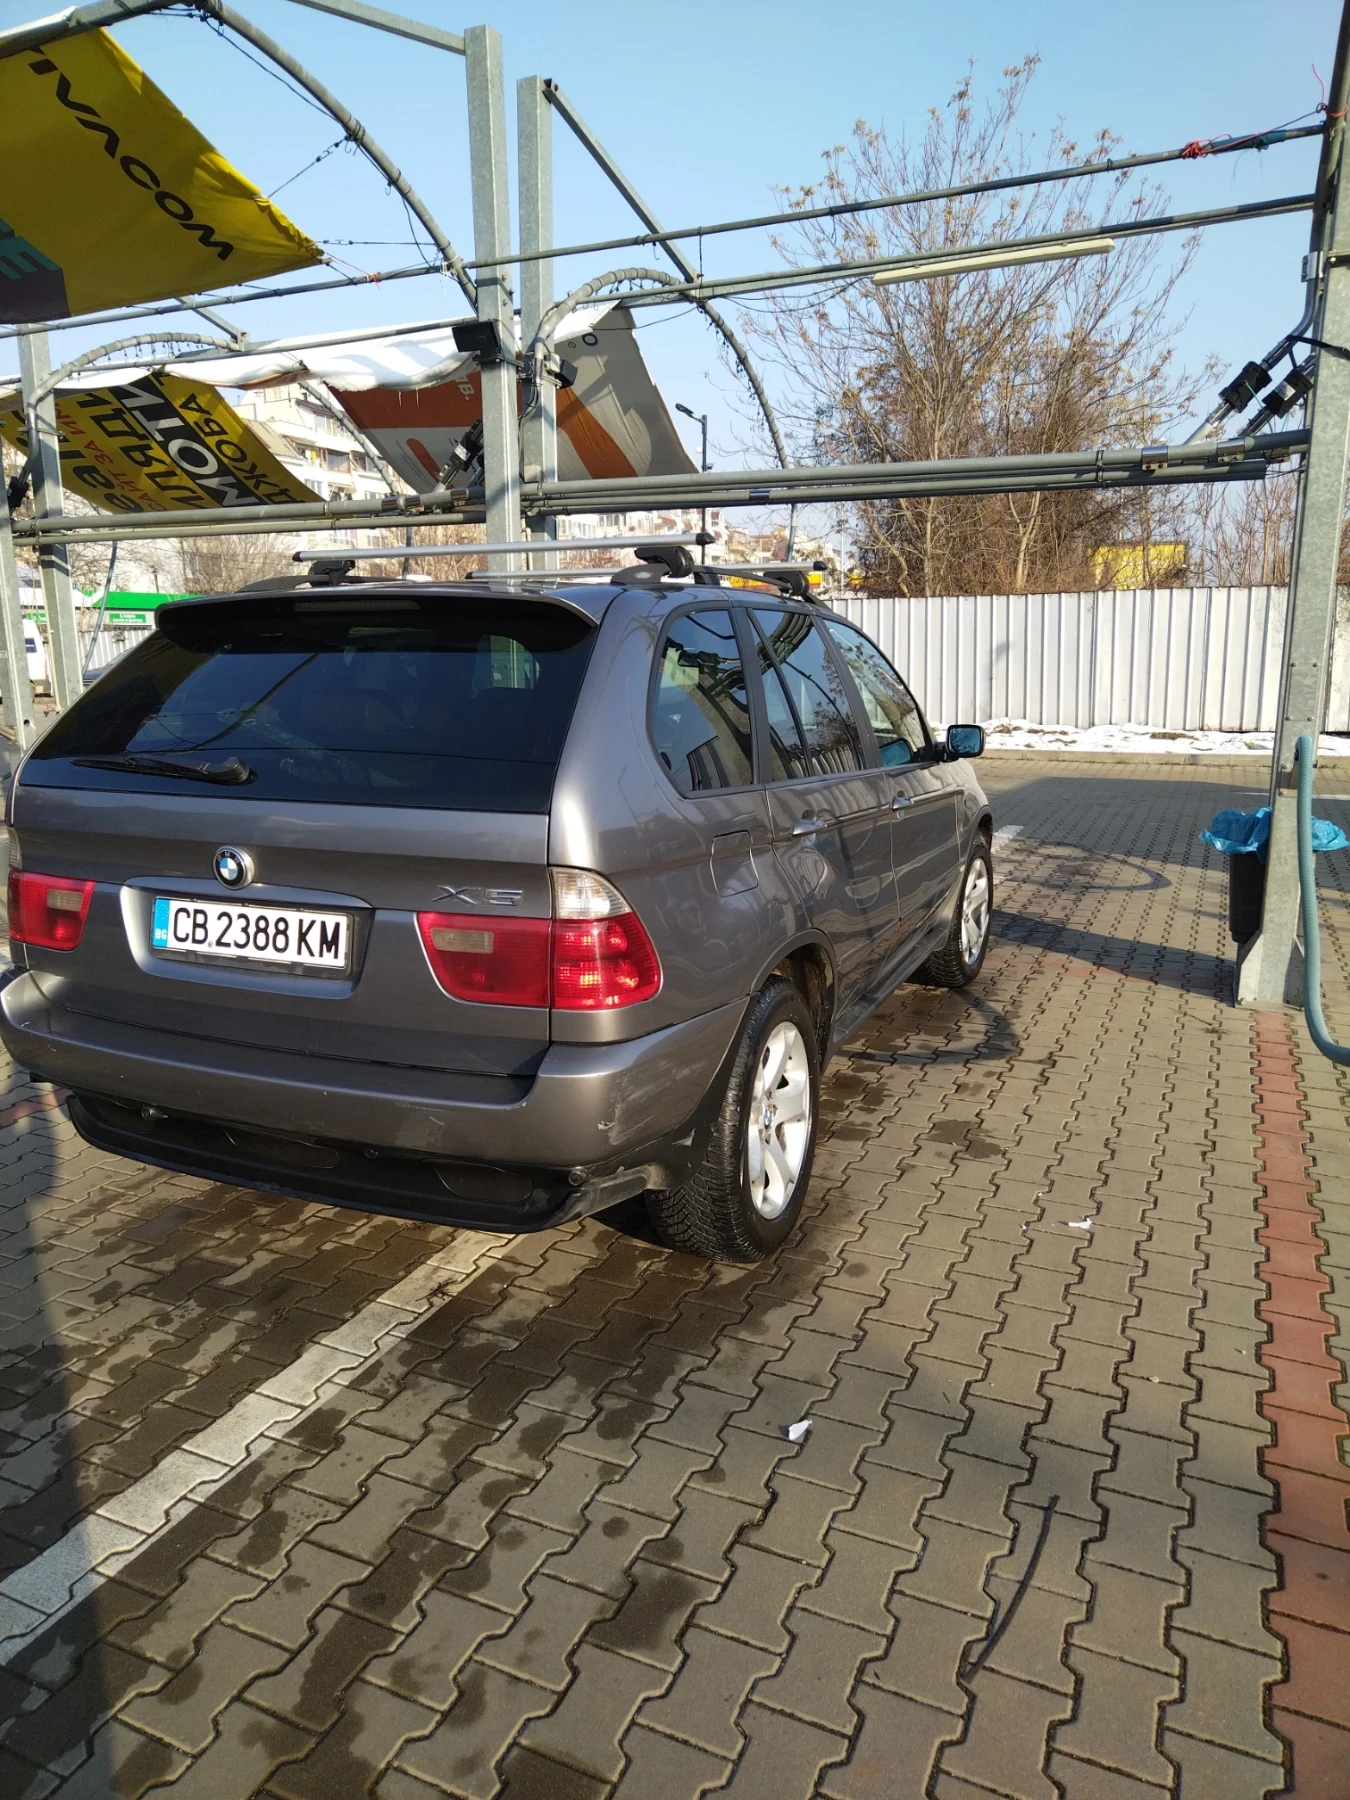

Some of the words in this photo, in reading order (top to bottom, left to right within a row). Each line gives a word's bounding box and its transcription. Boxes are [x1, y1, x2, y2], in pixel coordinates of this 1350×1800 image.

[28, 48, 234, 261] IVACOM
[76, 393, 207, 509] ИЛЯДИ
[84, 440, 113, 464] ЗА
[431, 885, 523, 906] X5
[155, 928, 168, 941] BG
